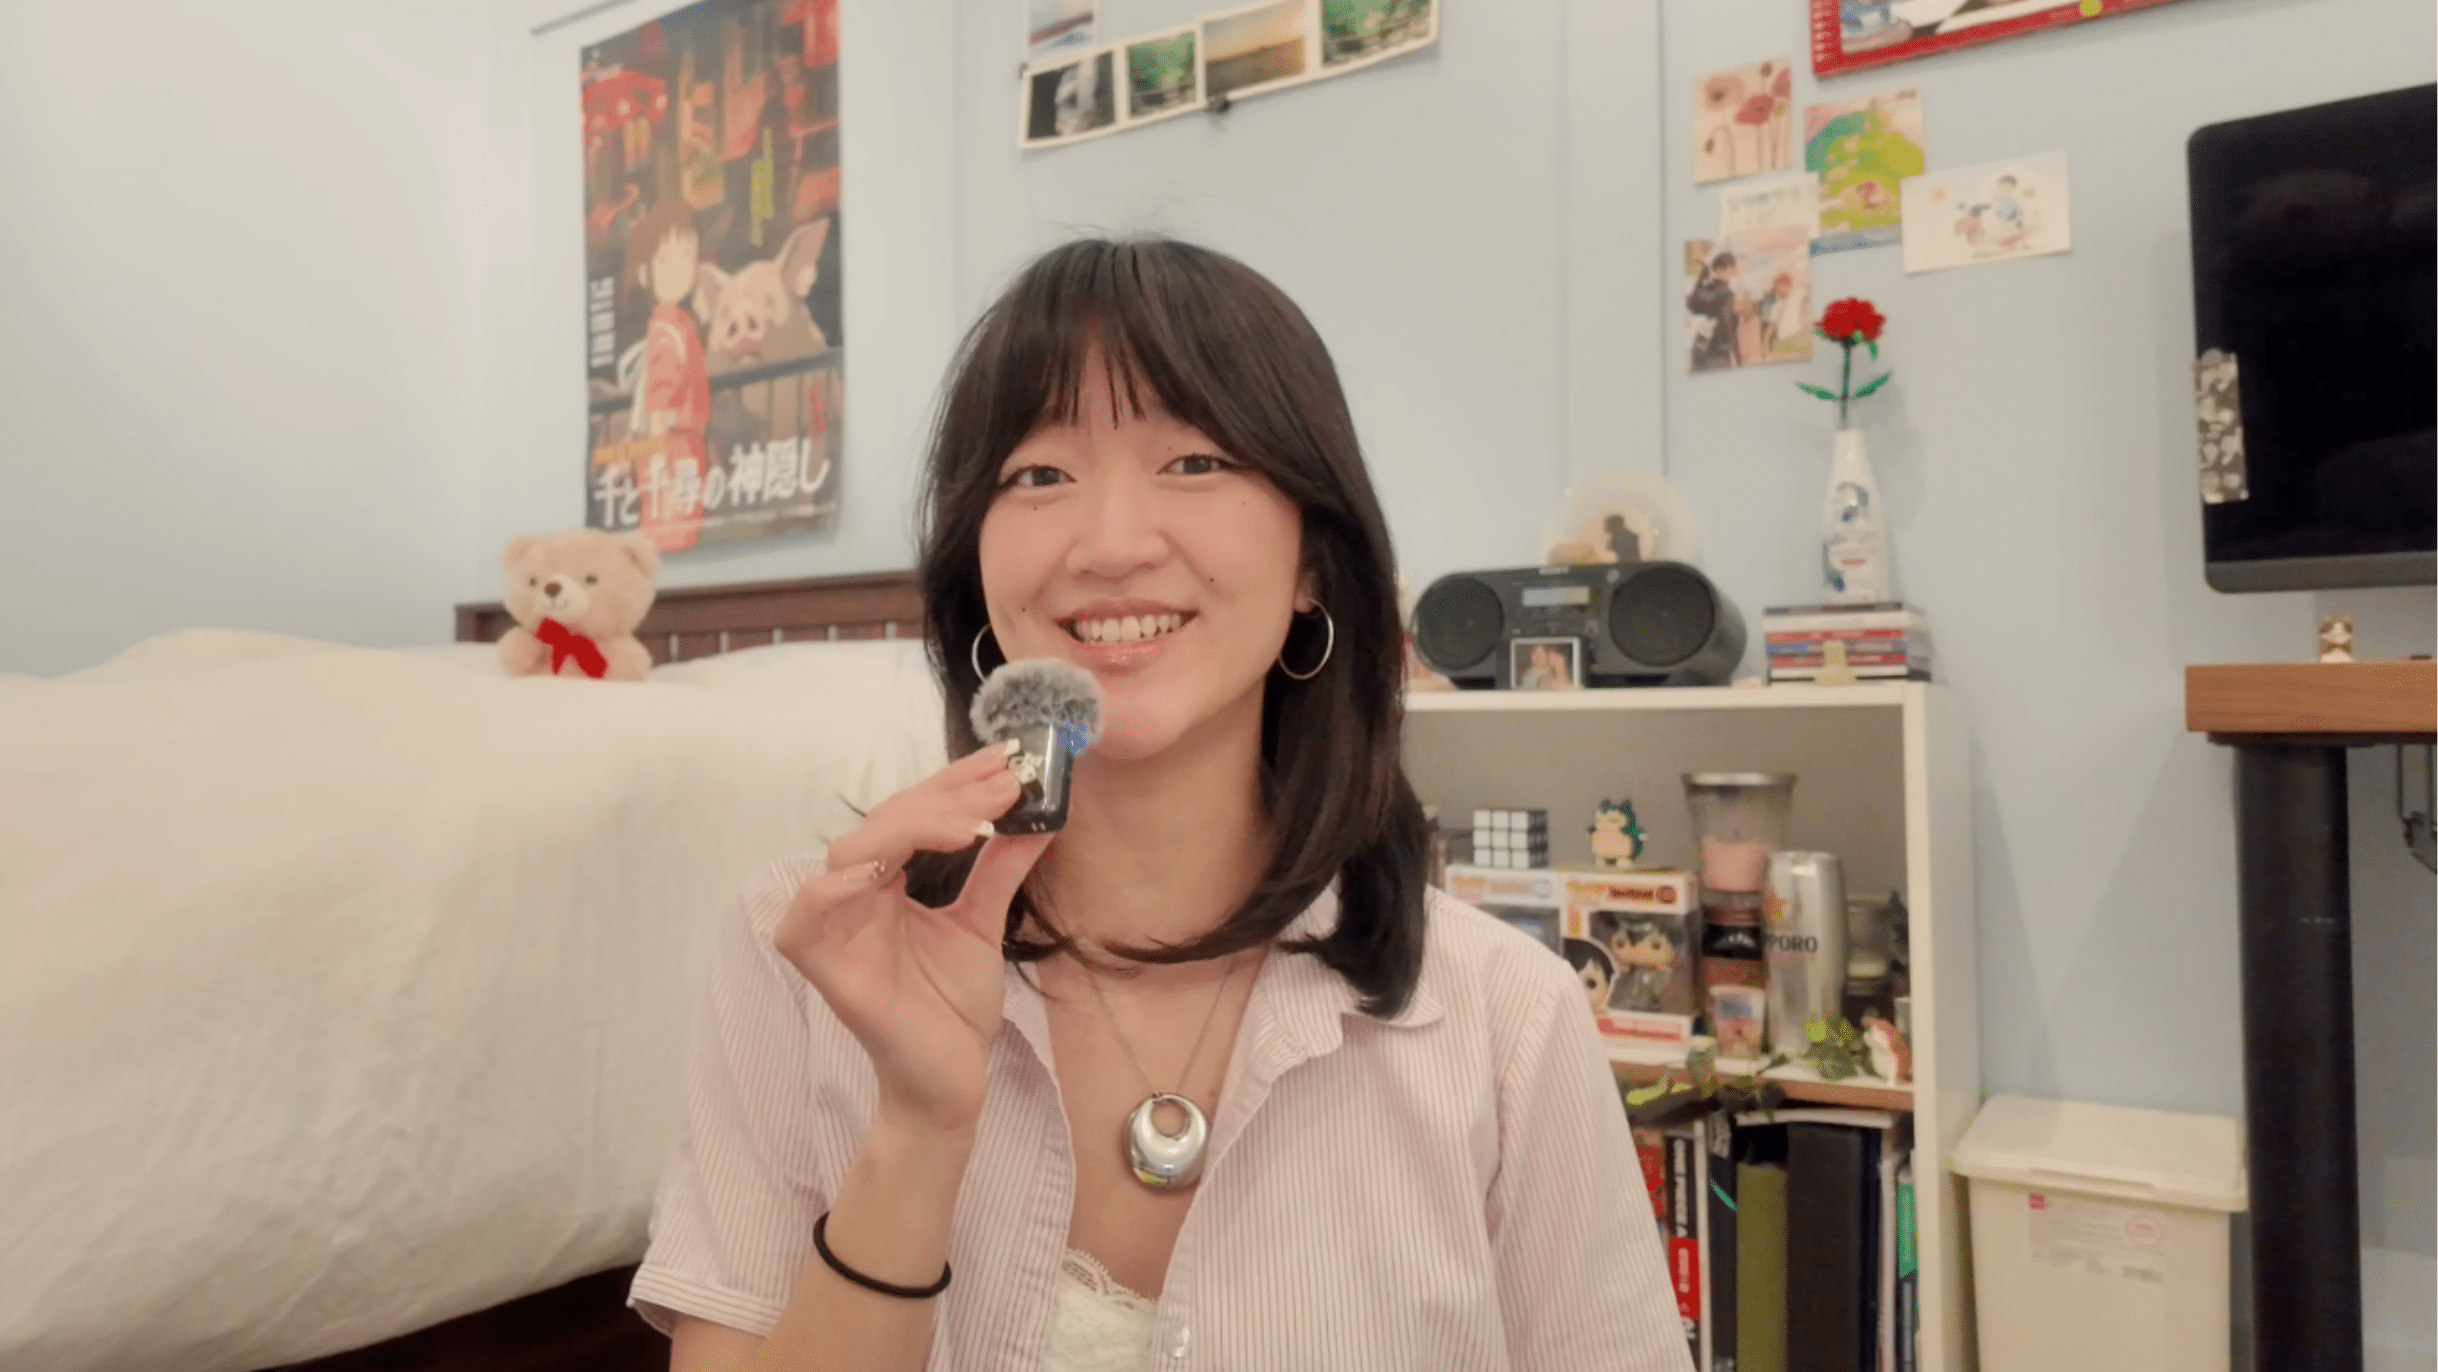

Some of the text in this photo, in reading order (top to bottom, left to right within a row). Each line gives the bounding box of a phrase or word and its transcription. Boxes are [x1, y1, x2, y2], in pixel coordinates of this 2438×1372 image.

[593, 436, 831, 529] 千と千尋の神隠し
